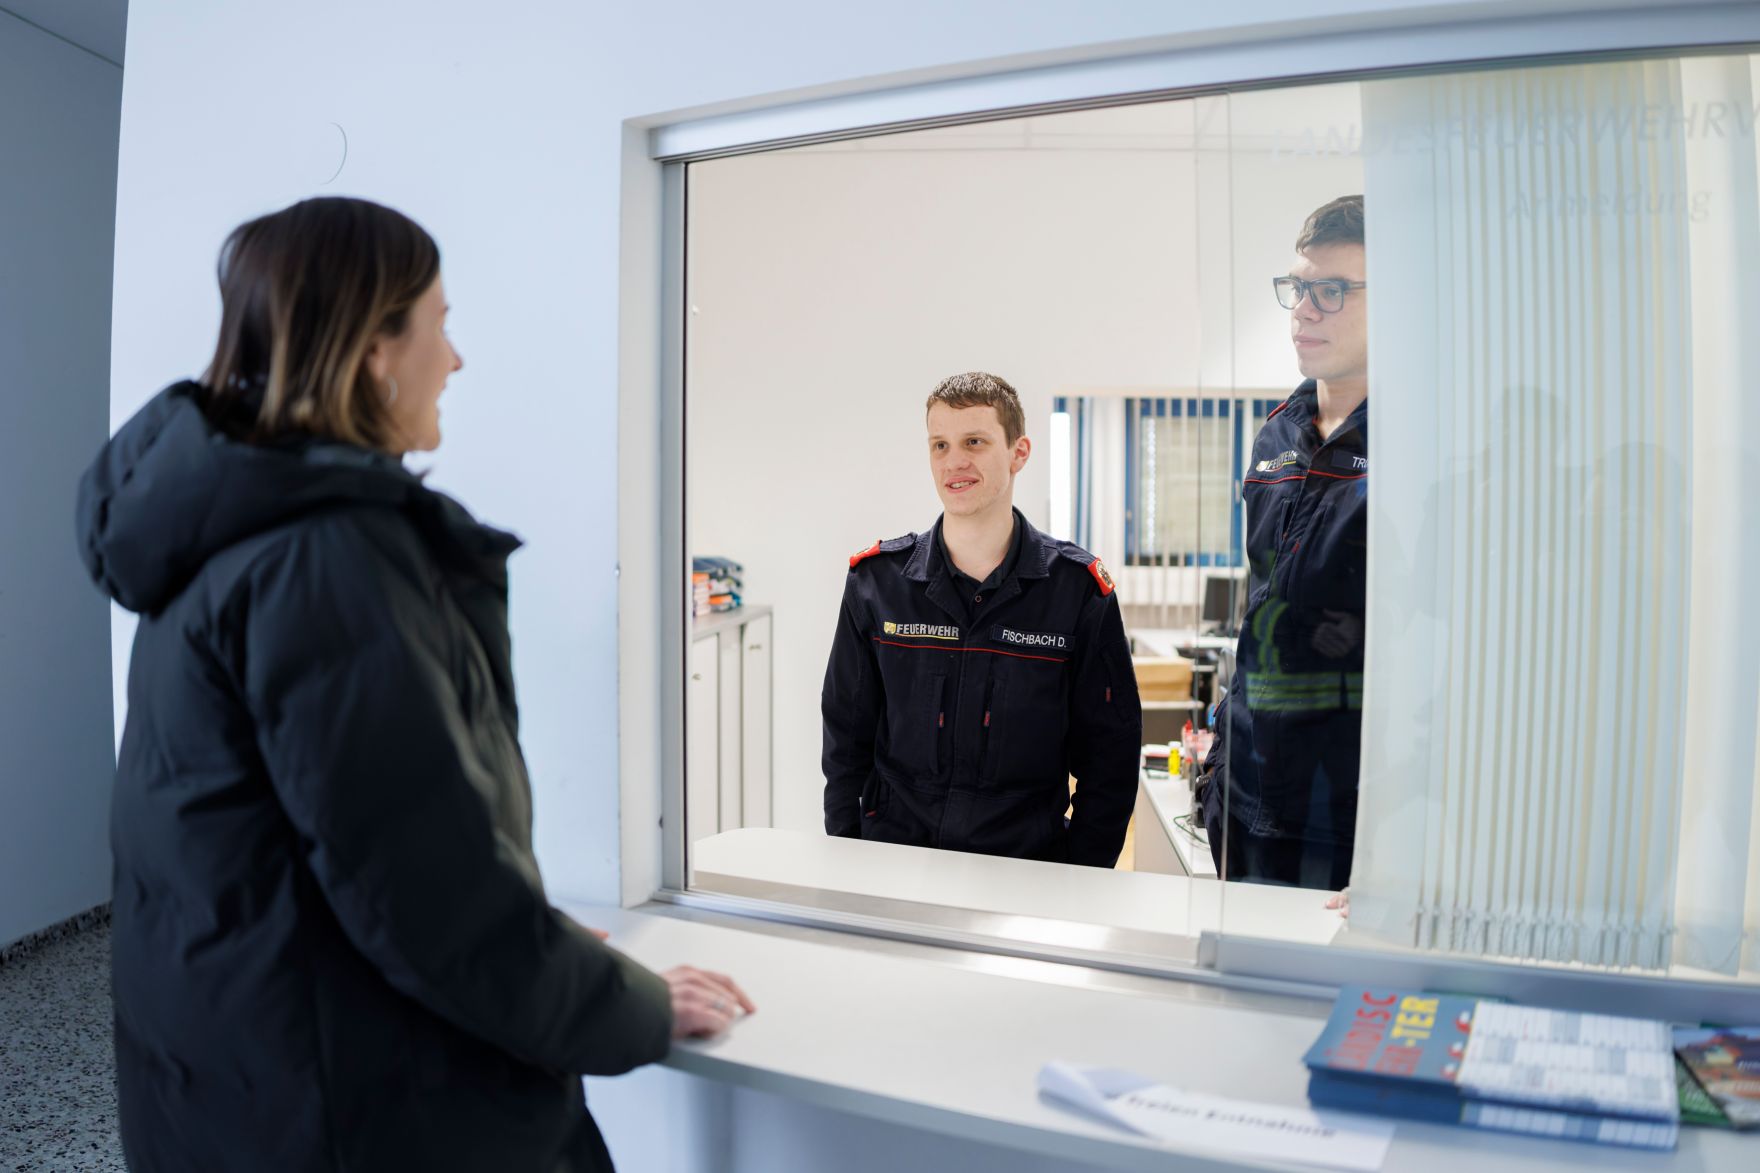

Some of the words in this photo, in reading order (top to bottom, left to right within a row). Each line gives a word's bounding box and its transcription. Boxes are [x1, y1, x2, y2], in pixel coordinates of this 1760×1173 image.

[896, 623, 959, 637] FEUERWEHR
[1002, 629, 1056, 647] FISCHBACH
[1057, 636, 1067, 648] D.
